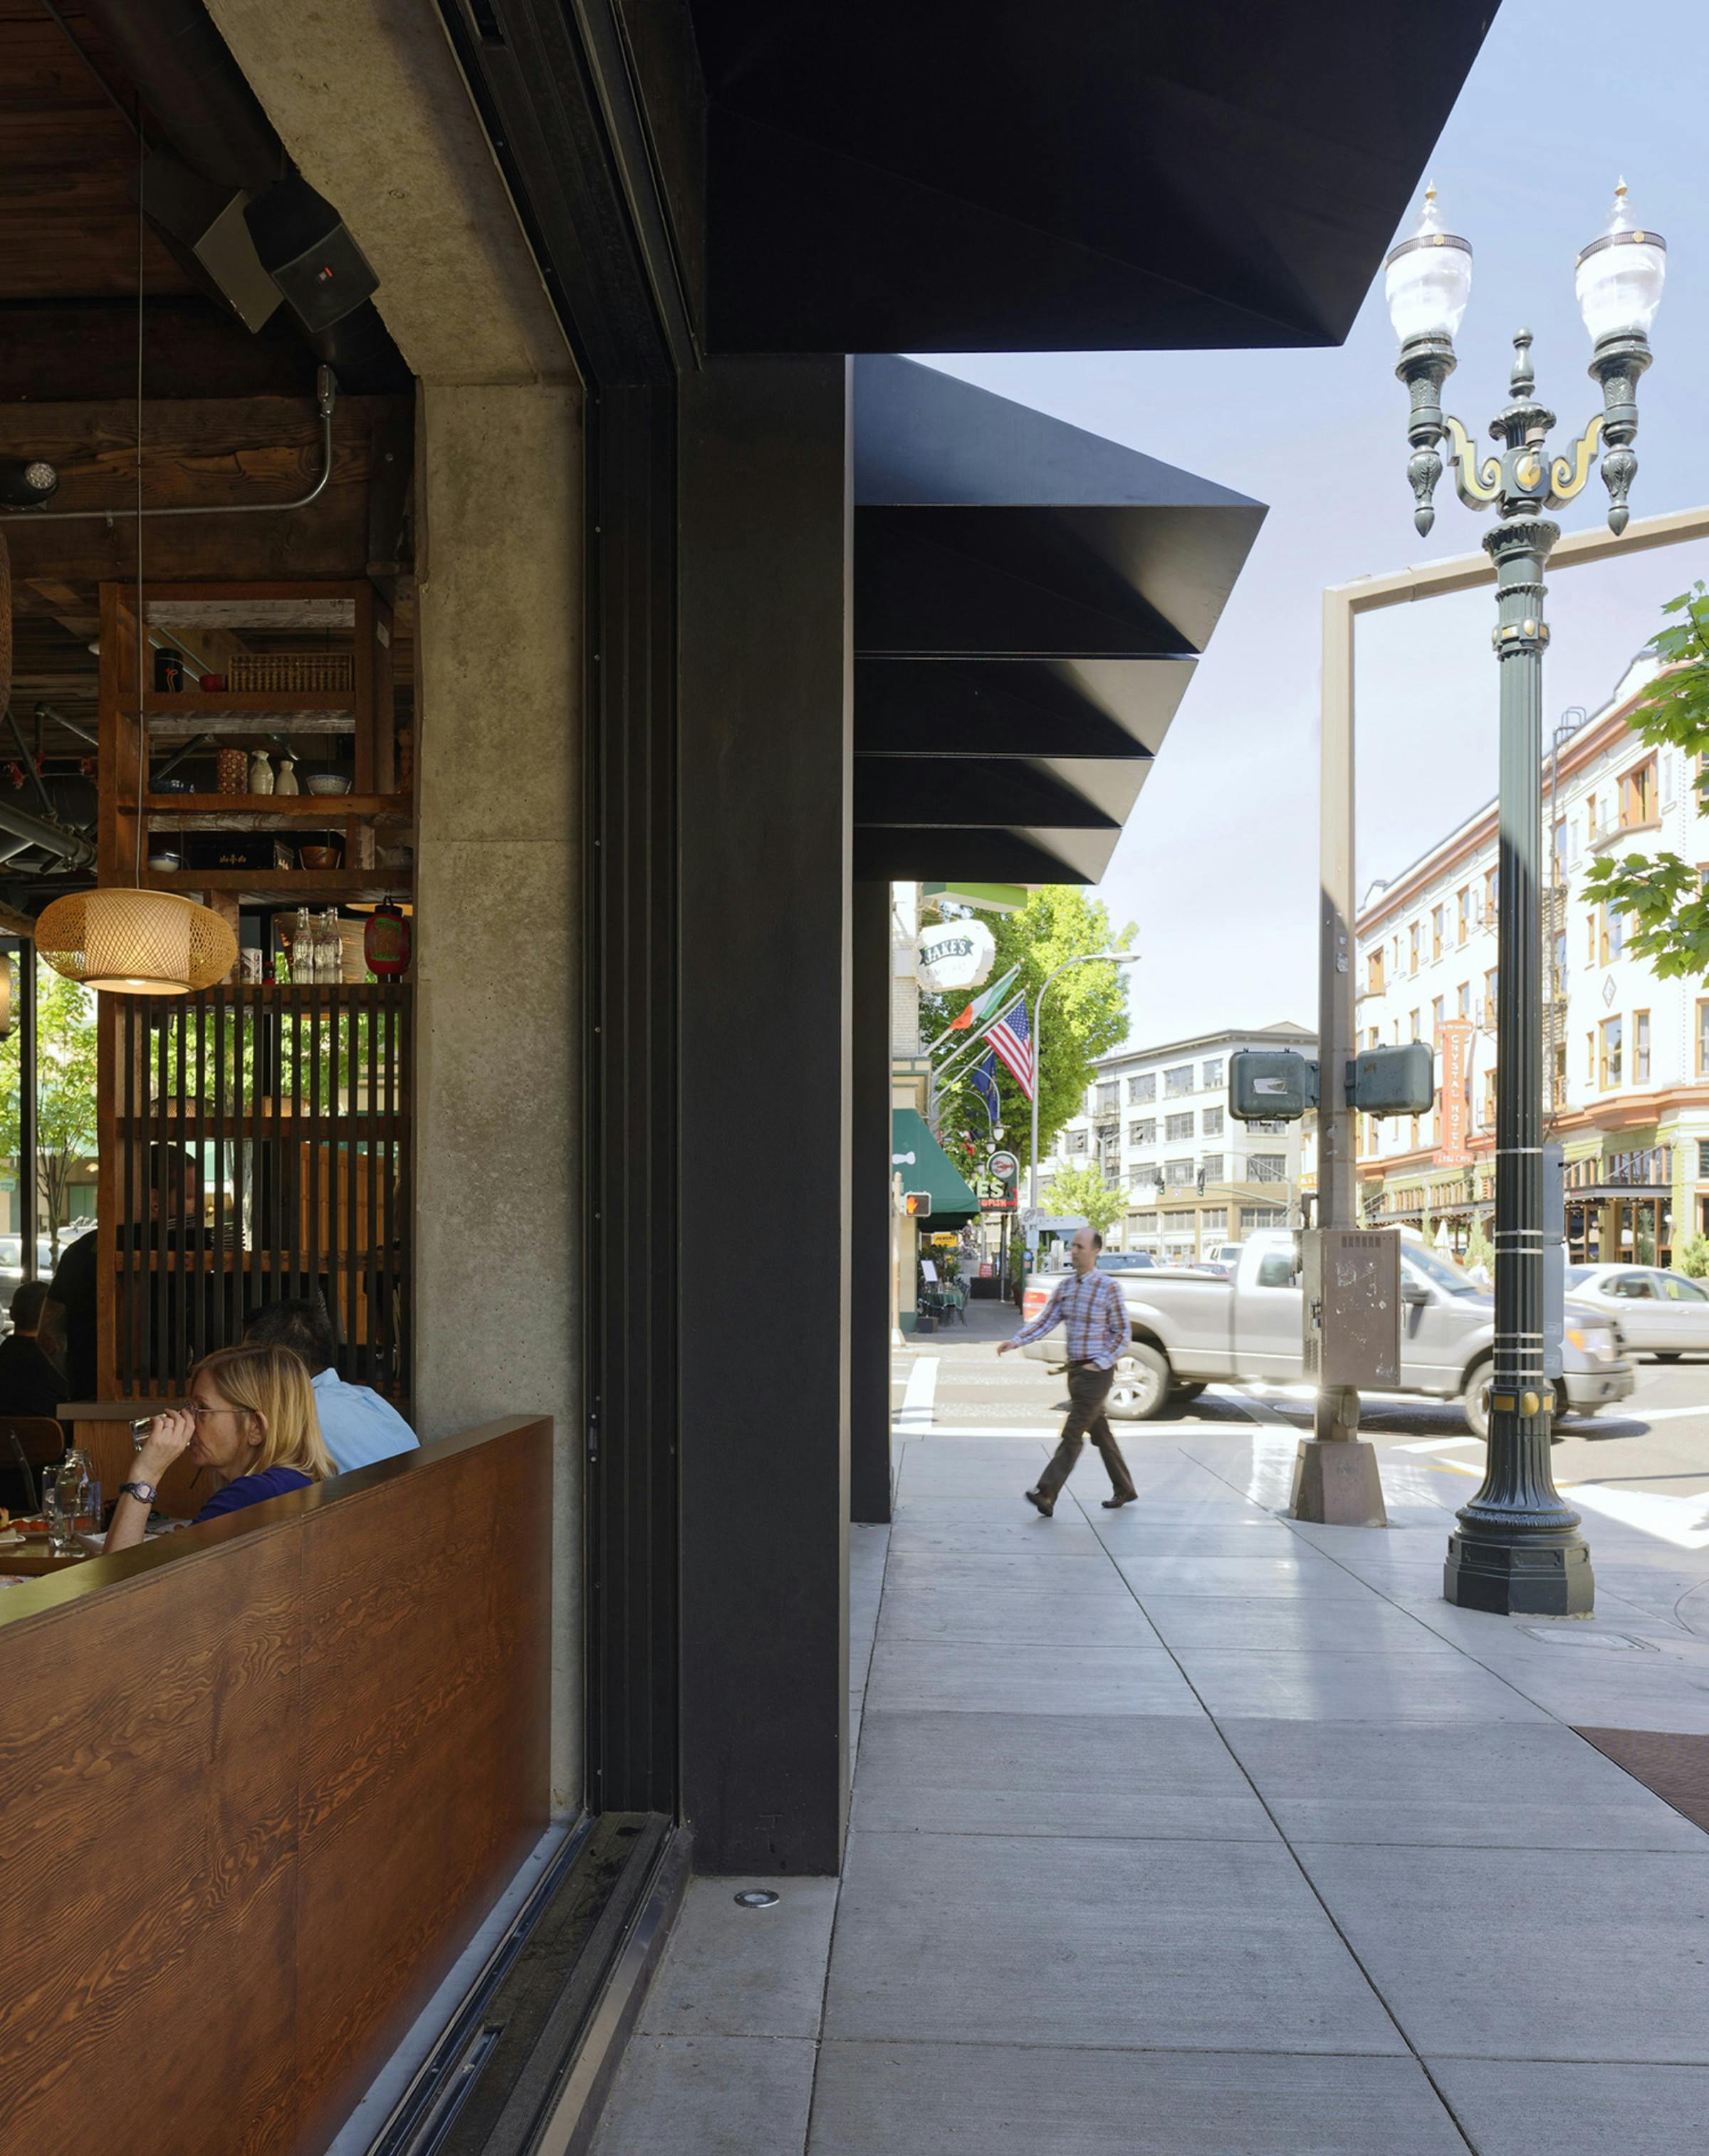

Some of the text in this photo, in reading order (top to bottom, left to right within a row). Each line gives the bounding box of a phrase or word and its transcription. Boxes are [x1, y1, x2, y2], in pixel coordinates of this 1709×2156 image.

[925, 939, 966, 963] JAKE'S
[1451, 1033, 1460, 1150] CRYSTAL HOTEL
